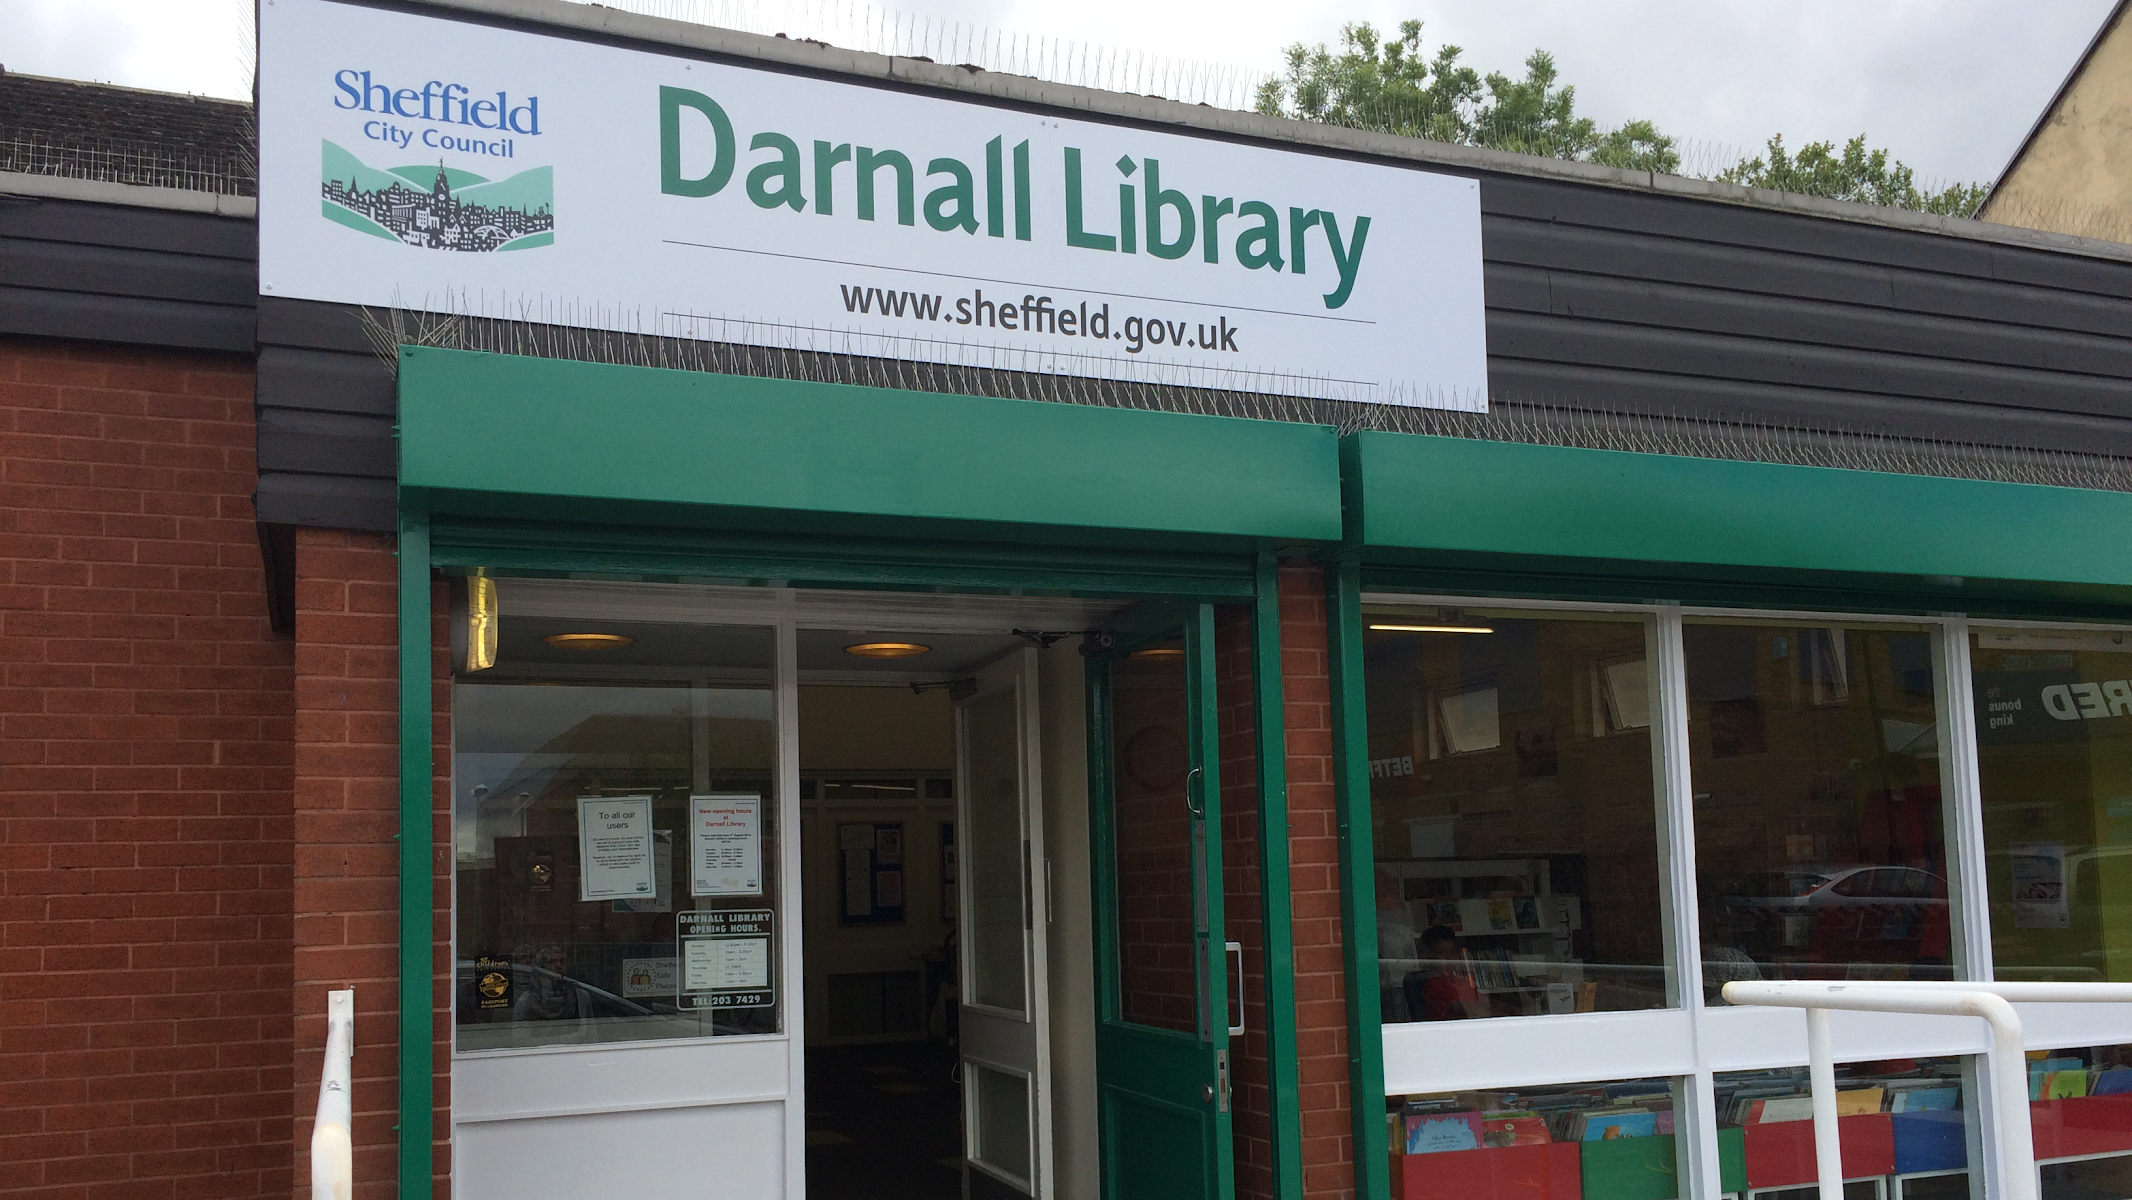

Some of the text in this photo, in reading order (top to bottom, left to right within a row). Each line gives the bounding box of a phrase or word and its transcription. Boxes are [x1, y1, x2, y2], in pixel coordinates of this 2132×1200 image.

[334, 69, 542, 136] Sheffield
[363, 121, 514, 158] City Council
[660, 85, 1371, 309] Darnall Library
[840, 283, 1240, 354] www.sheffield.gov.uk
[599, 812, 609, 820] To
[606, 822, 629, 830] users
[680, 913, 771, 924] DARNALL LIBRARY
[690, 924, 727, 934] OPENING
[736, 995, 761, 1004] 7429
